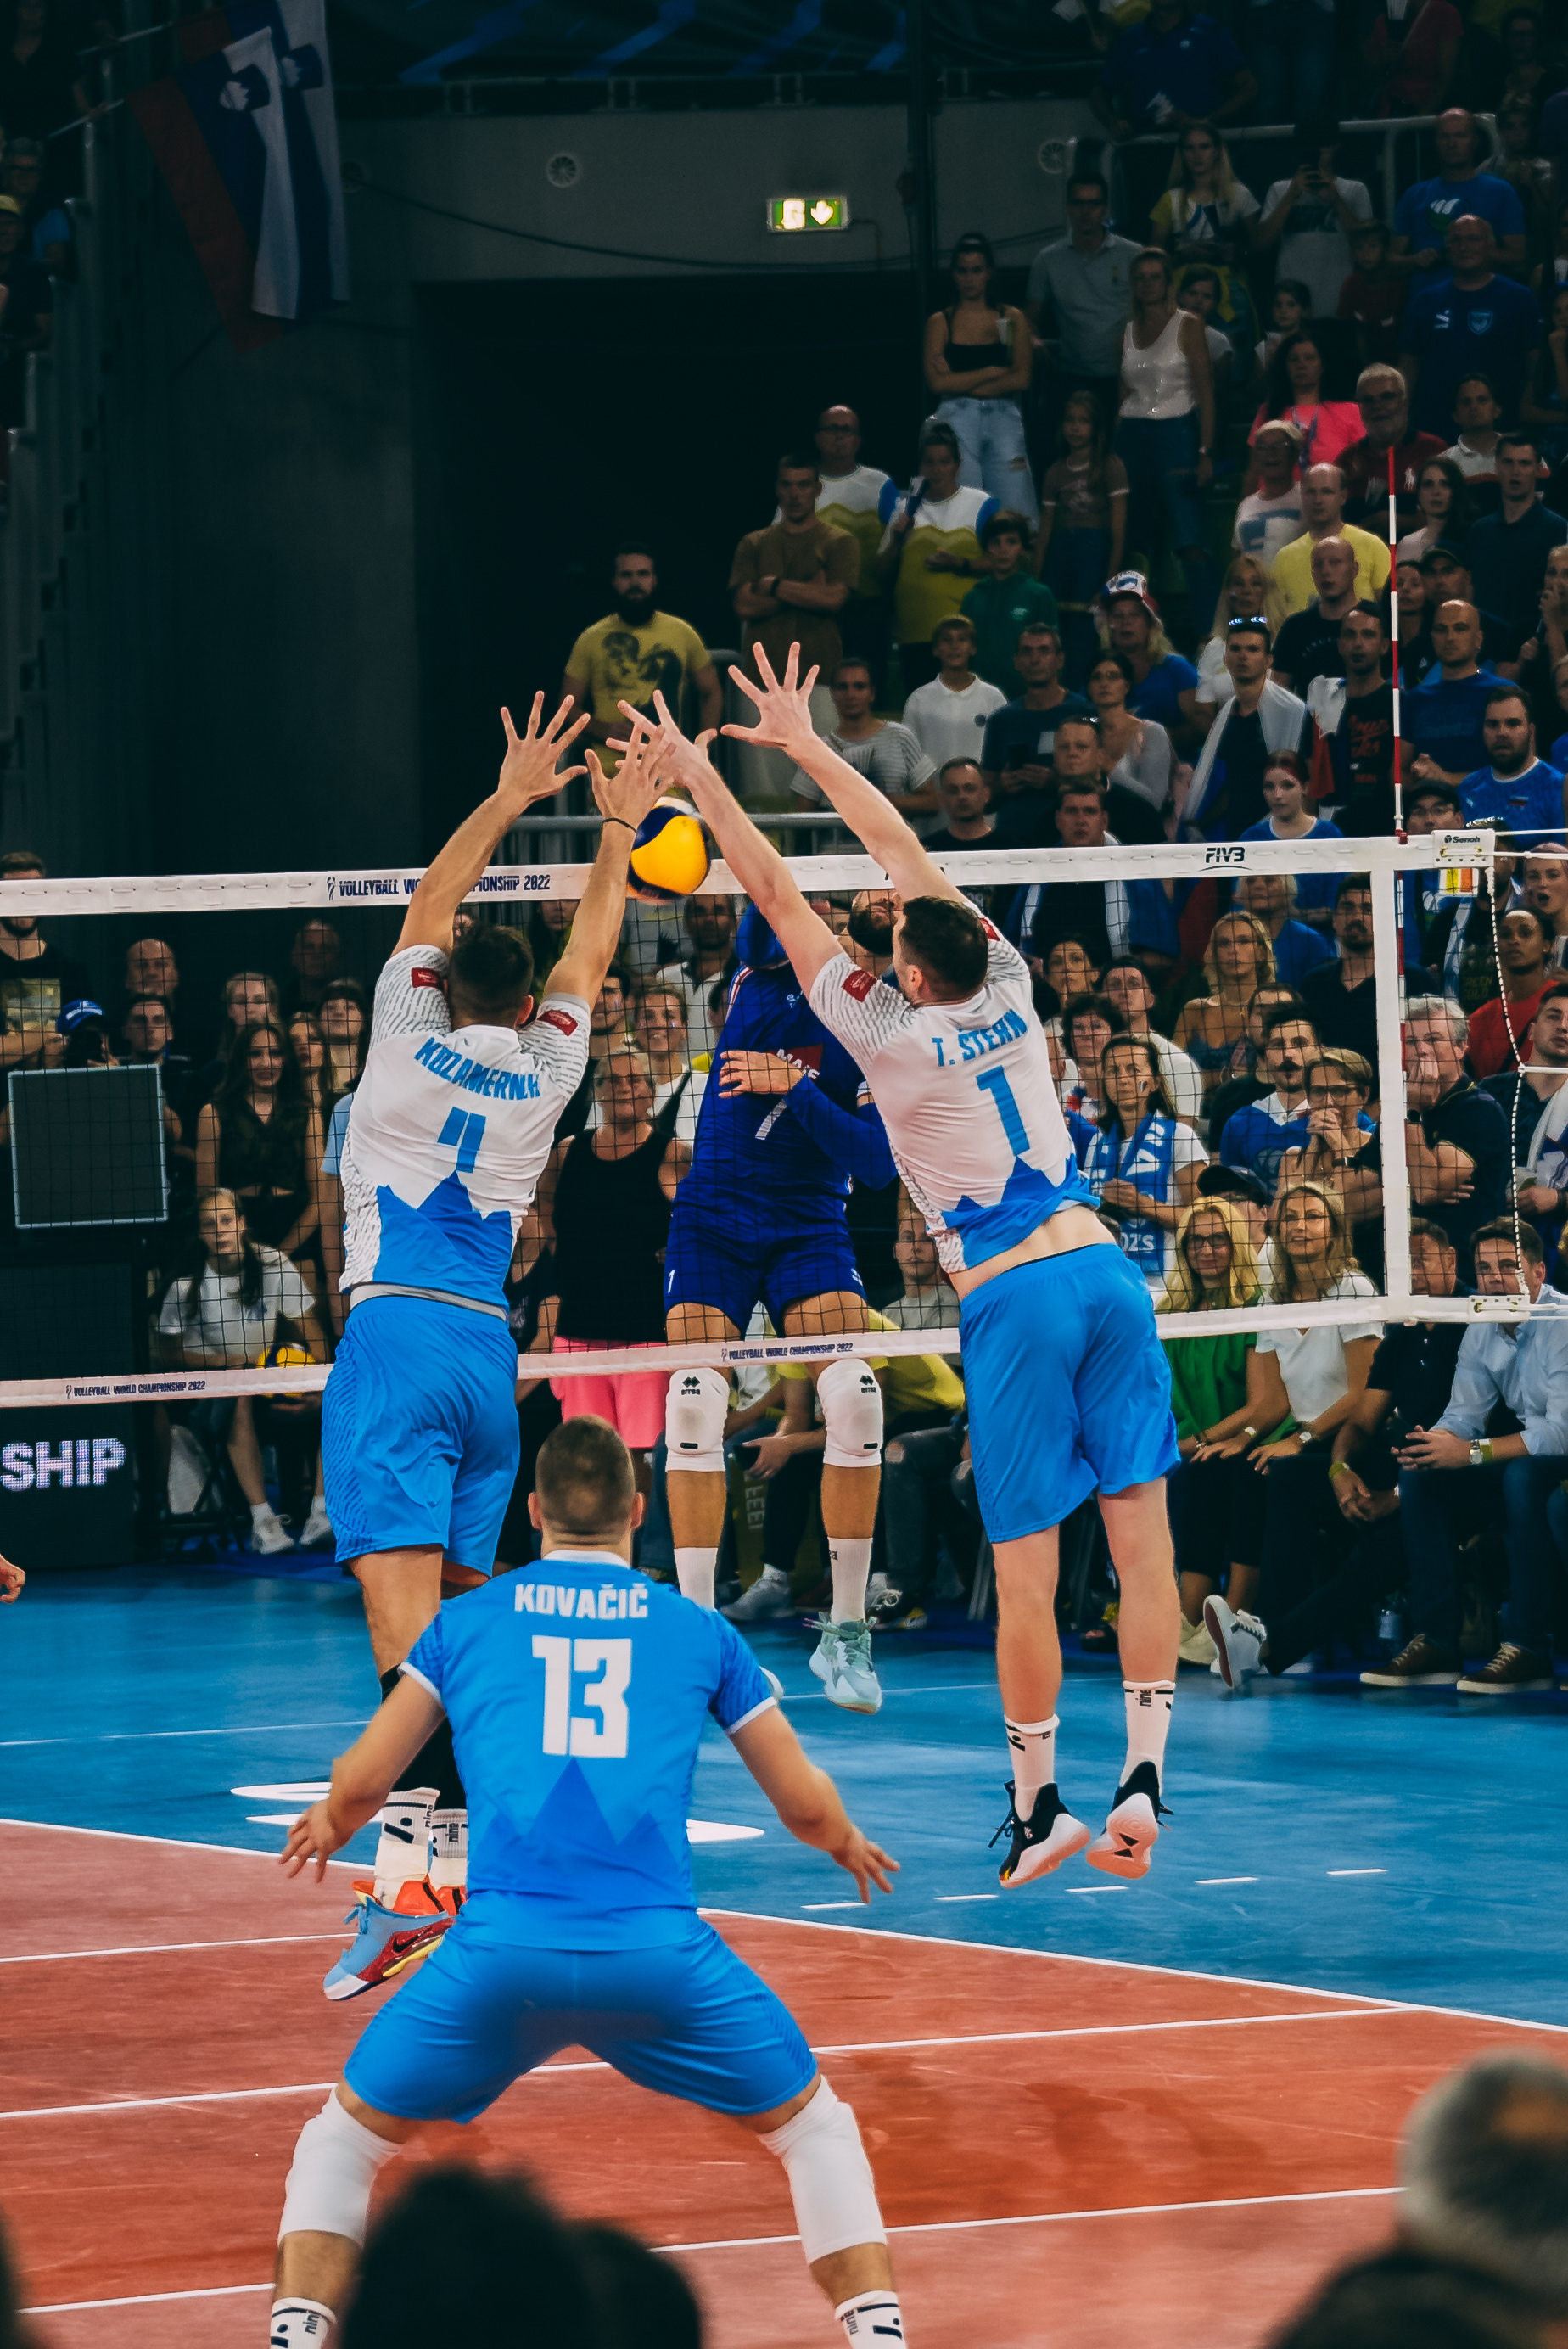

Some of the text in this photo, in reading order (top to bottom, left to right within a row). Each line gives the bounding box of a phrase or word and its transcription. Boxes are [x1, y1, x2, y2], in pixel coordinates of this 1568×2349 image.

[1205, 846, 1246, 864] FIVB
[339, 878, 399, 896] VOLLEYBALL
[524, 874, 551, 890] 2022
[932, 1037, 955, 1067] T.
[414, 1037, 541, 1100] KOZAMERNK
[976, 1065, 1031, 1157] 1
[729, 1343, 854, 1360] VOLLEYBALL WORLD CHAMPIONSHIP 2022
[74, 1380, 206, 1397] VOLLEYBALL WORLD CHAMPIONSHIP 2022
[0, 1438, 126, 1492] SHIP
[514, 1583, 648, 1620] KOVAČIČ
[531, 1634, 632, 1758] 13
[445, 1823, 459, 1843] nine
